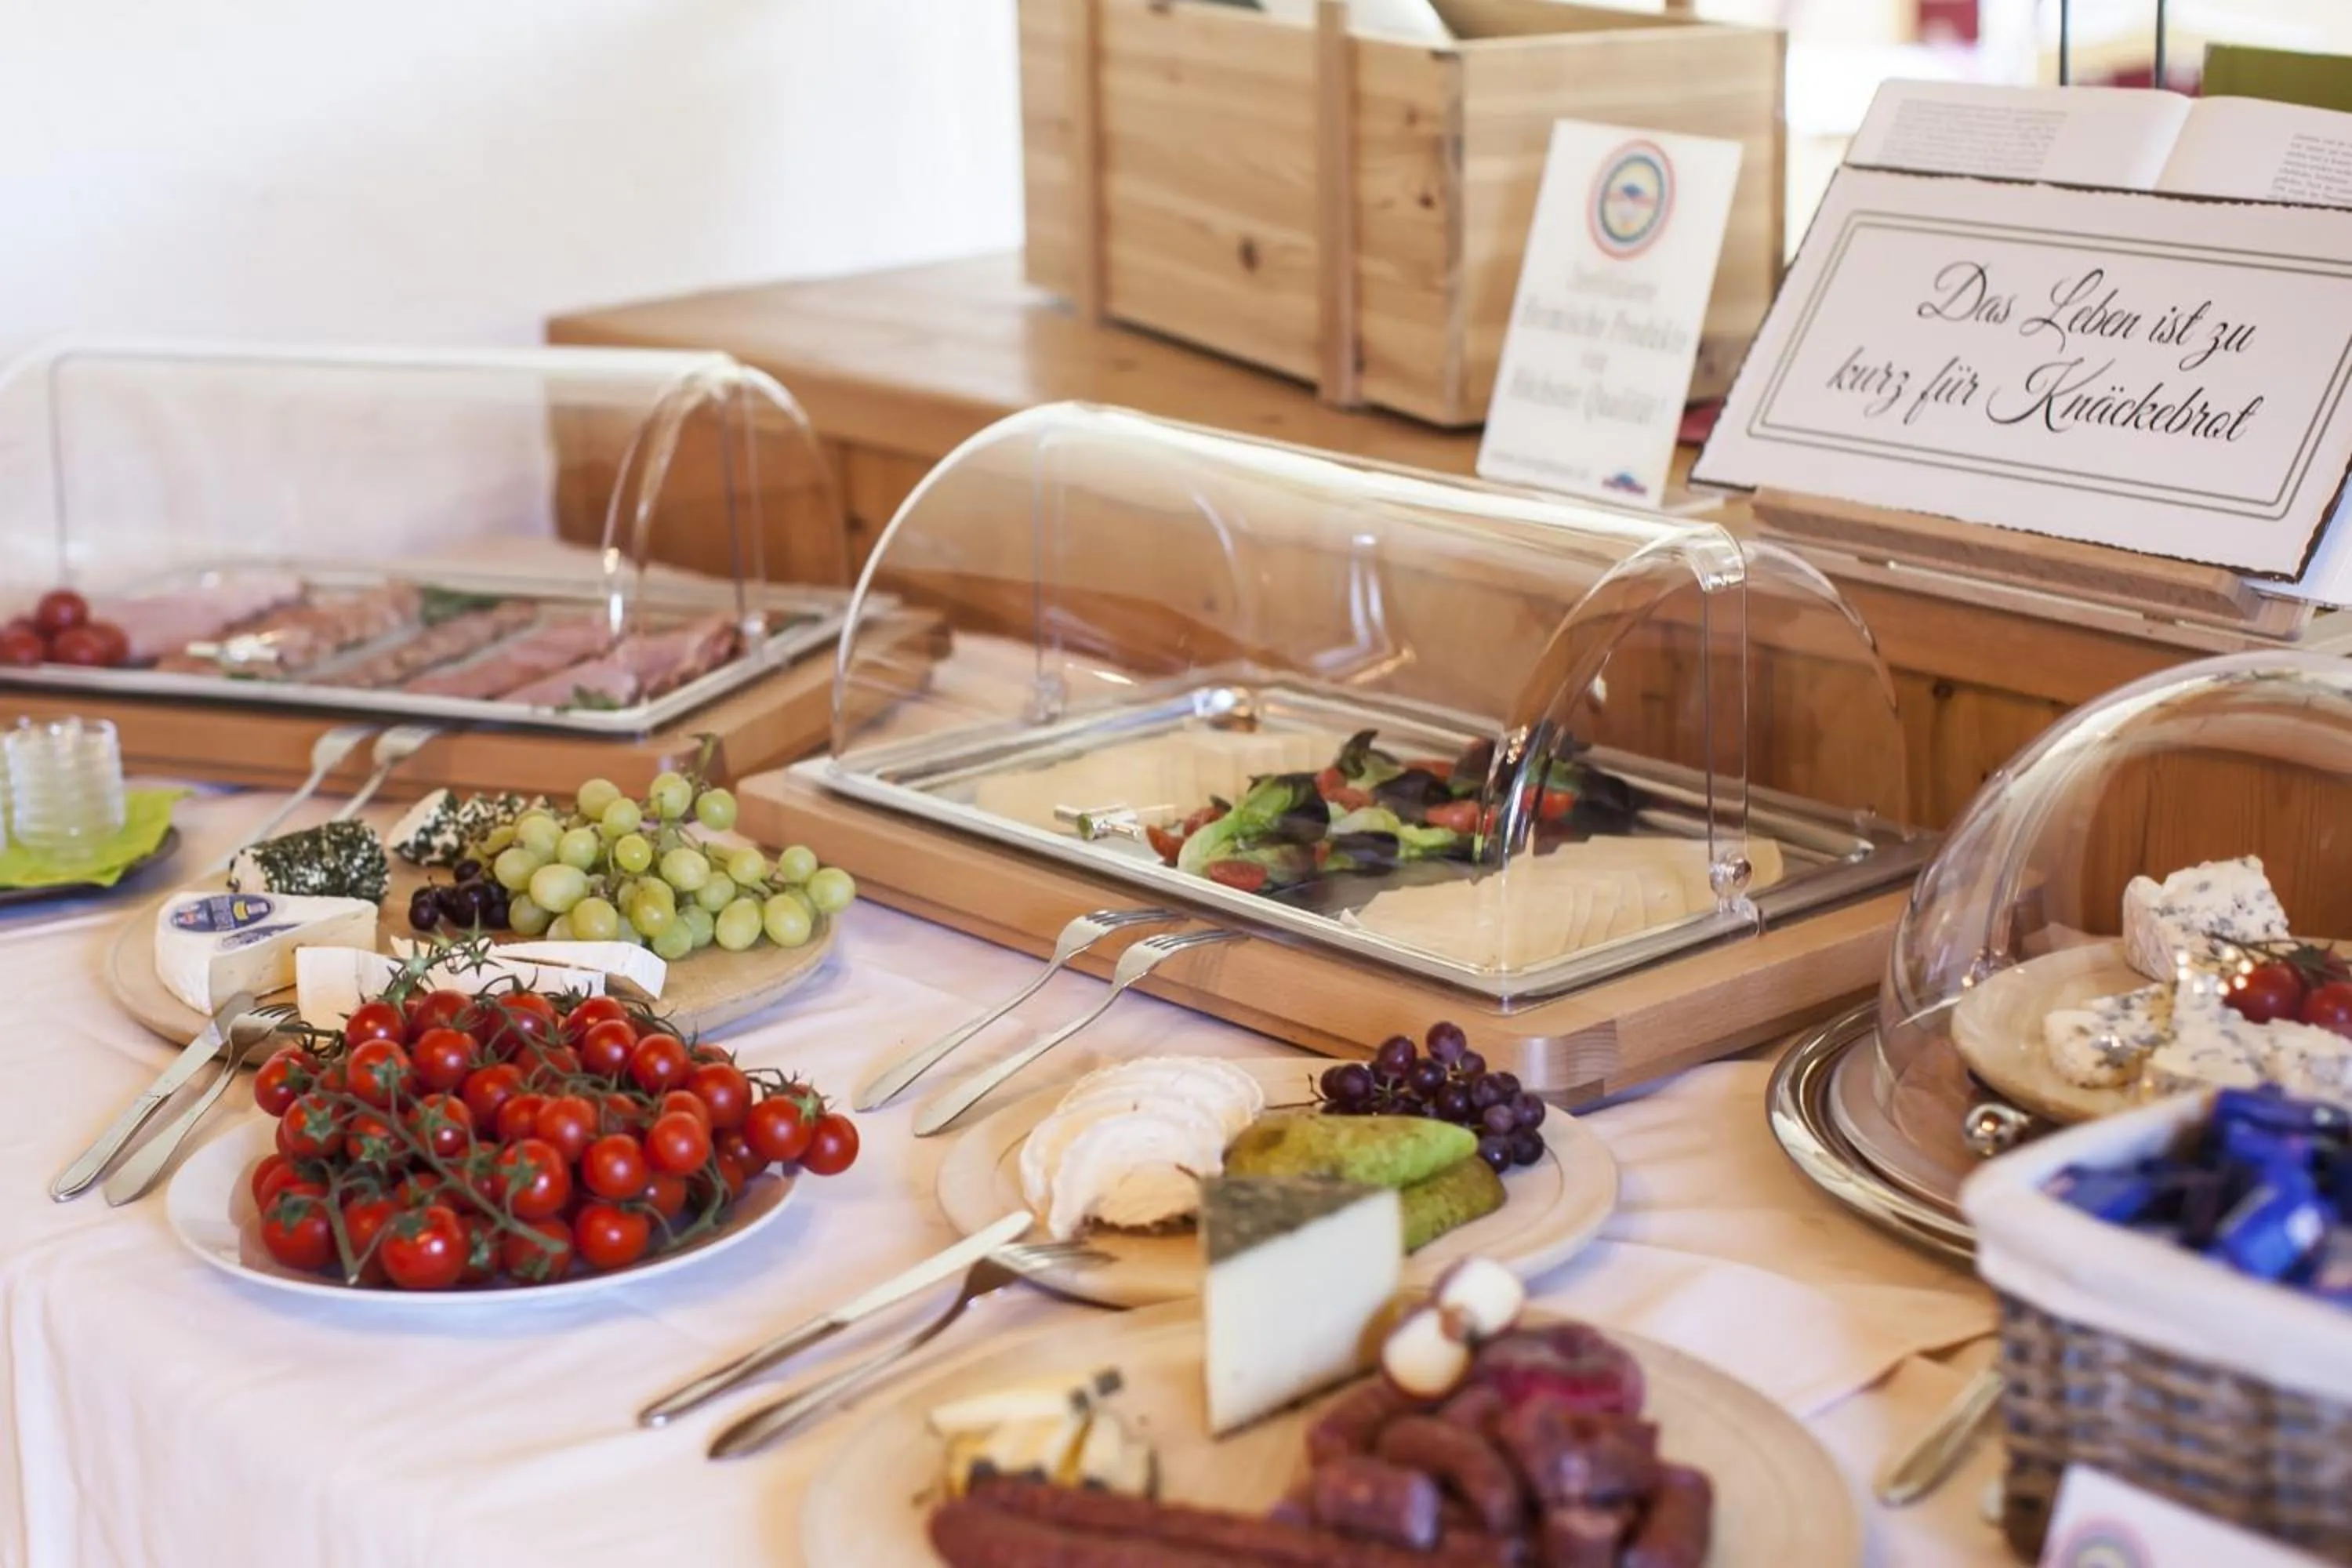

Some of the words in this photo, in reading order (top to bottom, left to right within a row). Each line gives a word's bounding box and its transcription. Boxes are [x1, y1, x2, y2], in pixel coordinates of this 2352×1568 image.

[1918, 261, 2018, 324] Das
[2019, 268, 2141, 354] Leben
[2148, 300, 2212, 346] ist
[2179, 321, 2256, 372] zu
[1825, 347, 1910, 418] kurz
[1903, 356, 1979, 426] für
[1986, 357, 2264, 441] Knäckebrot
